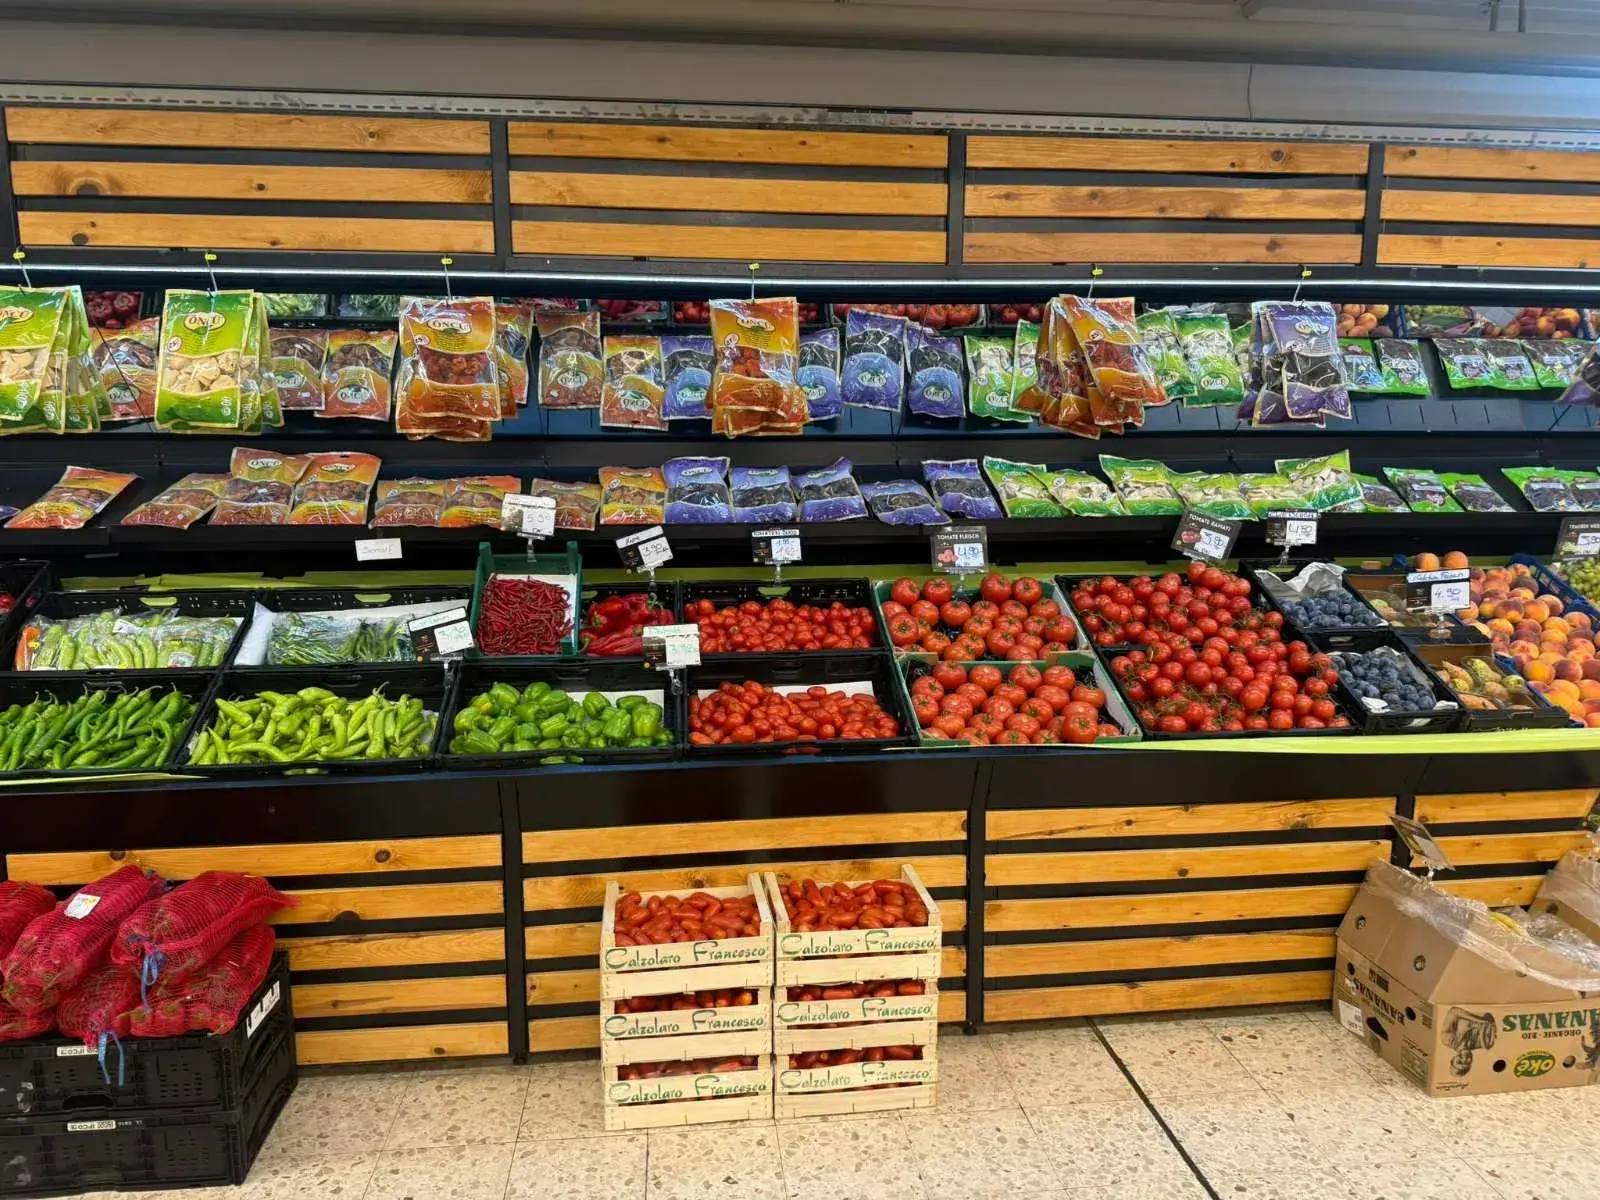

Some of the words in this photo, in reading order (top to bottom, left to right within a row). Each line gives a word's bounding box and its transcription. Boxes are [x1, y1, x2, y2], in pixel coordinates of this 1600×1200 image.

[605, 948, 681, 970] Calzolaro
[693, 941, 766, 962] Francesco
[781, 934, 853, 956] Calzolaro
[864, 930, 936, 951] Francesco
[605, 1016, 680, 1037] Calzolaro
[692, 1010, 764, 1031] Francesco
[777, 1002, 850, 1023] Calzolaro
[862, 998, 931, 1019] Francesco
[1521, 1031, 1538, 1040] BIO
[1543, 1029, 1582, 1039] ORGANIC
[781, 1069, 852, 1090] Calzolaro
[862, 1061, 930, 1082] Francesco
[609, 1082, 683, 1103] Calzolaro
[695, 1075, 767, 1096] Francesco
